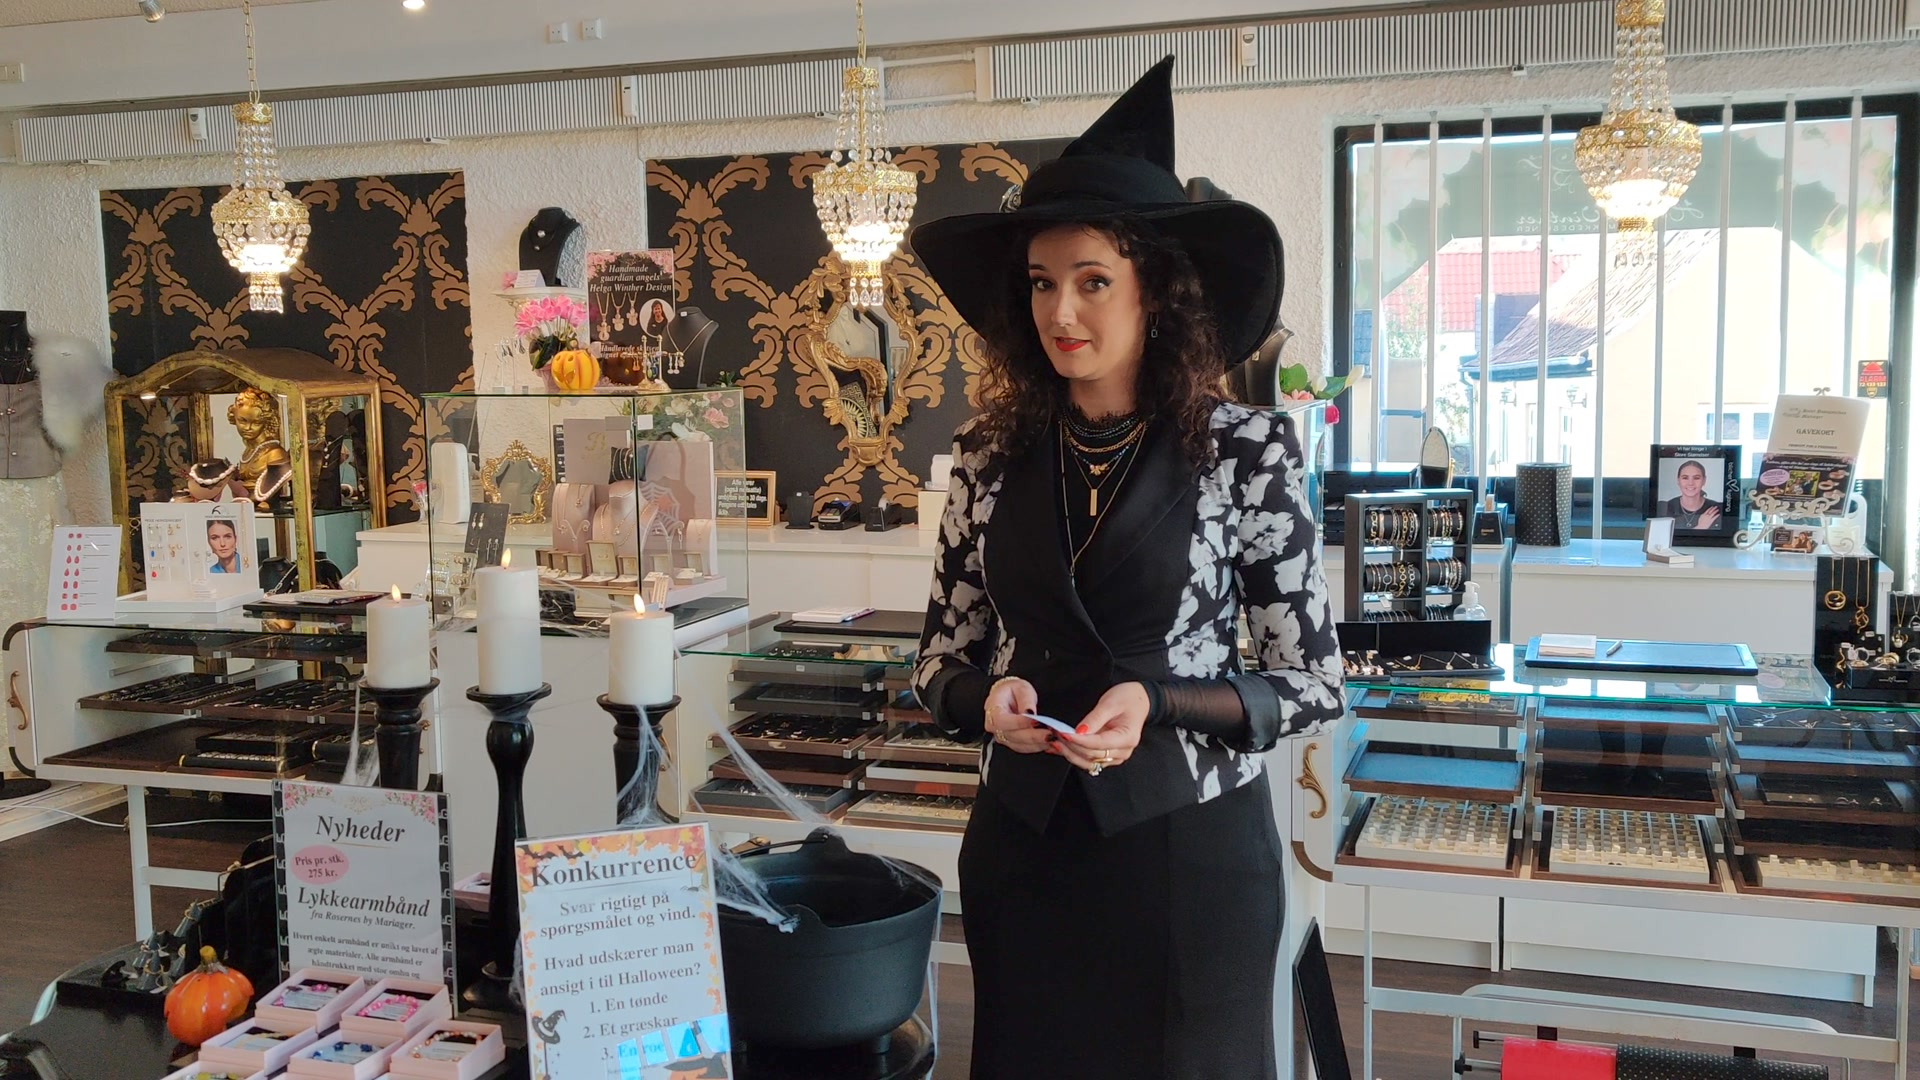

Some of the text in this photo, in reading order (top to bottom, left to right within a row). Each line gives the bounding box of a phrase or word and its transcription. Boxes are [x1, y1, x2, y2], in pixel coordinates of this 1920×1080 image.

[600, 274, 634, 282] guardian
[608, 264, 648, 273] Handmade
[590, 283, 672, 293] Helga Winther Design
[316, 815, 405, 842] Nyheder
[294, 854, 344, 867] Pris pr. stk.
[531, 854, 697, 887] Konkurrence
[308, 868, 338, 878] 275 kr.
[298, 886, 430, 917] Lykkearmbånd
[560, 889, 670, 916] Svar rigtigt på
[310, 911, 416, 930] fra Rosernes by Mariager.
[540, 906, 696, 940] spørgsmålet og vind.
[292, 932, 313, 941] Hvert
[314, 934, 336, 944] enkelt
[338, 936, 370, 948] armbånd
[411, 945, 429, 954] lavet
[430, 947, 438, 955] af
[312, 960, 355, 972] håndtrukket
[374, 966, 387, 974] stor
[325, 948, 364, 959] materialer.
[366, 953, 379, 961] Alle
[381, 954, 413, 965] armbånd
[544, 942, 694, 970] Hvad udskærer man
[540, 962, 701, 997] ansigt i til Halloween?
[590, 992, 668, 1014] 1. En tønde
[582, 1016, 678, 1039] 2. Et græskar
[601, 1043, 665, 1060] 3. En roe
